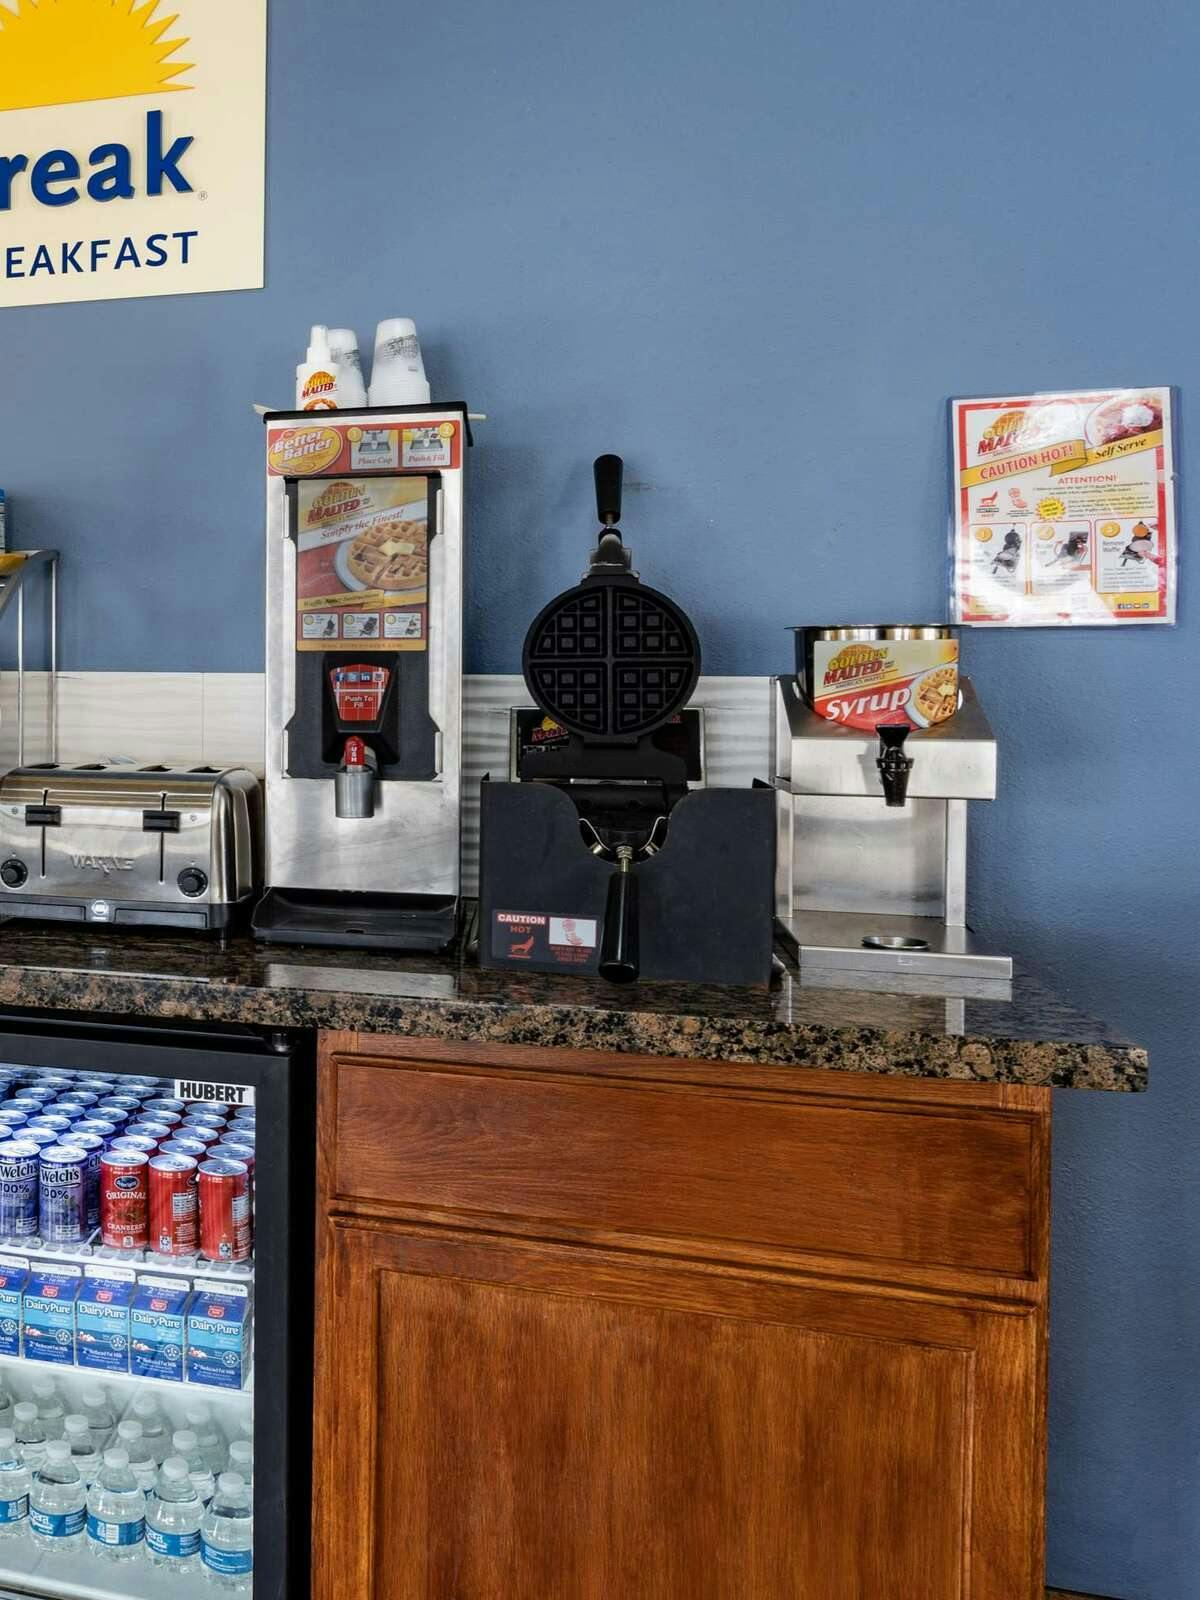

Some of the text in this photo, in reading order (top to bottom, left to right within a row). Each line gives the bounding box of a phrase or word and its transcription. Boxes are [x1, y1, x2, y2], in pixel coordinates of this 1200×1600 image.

[274, 431, 323, 454] Better
[283, 439, 333, 460] Batter
[979, 438, 1147, 480] CAUTION HOT! Self Serve
[1056, 475, 1117, 485] ATTENTION!
[823, 660, 883, 686] MALTED
[825, 687, 911, 720] Syrup
[497, 914, 546, 925] CAUTION
[510, 926, 532, 934] HOT
[179, 1082, 246, 1102] HUBERT
[41, 1168, 80, 1184] Welch's
[0, 1183, 30, 1194] 100%
[106, 1190, 147, 1201] ORIGINAL
[26, 1299, 70, 1314] DairyPure
[79, 1304, 126, 1319] DairyPure
[133, 1312, 181, 1329] DairyPure
[190, 1319, 239, 1335] DairyPure
